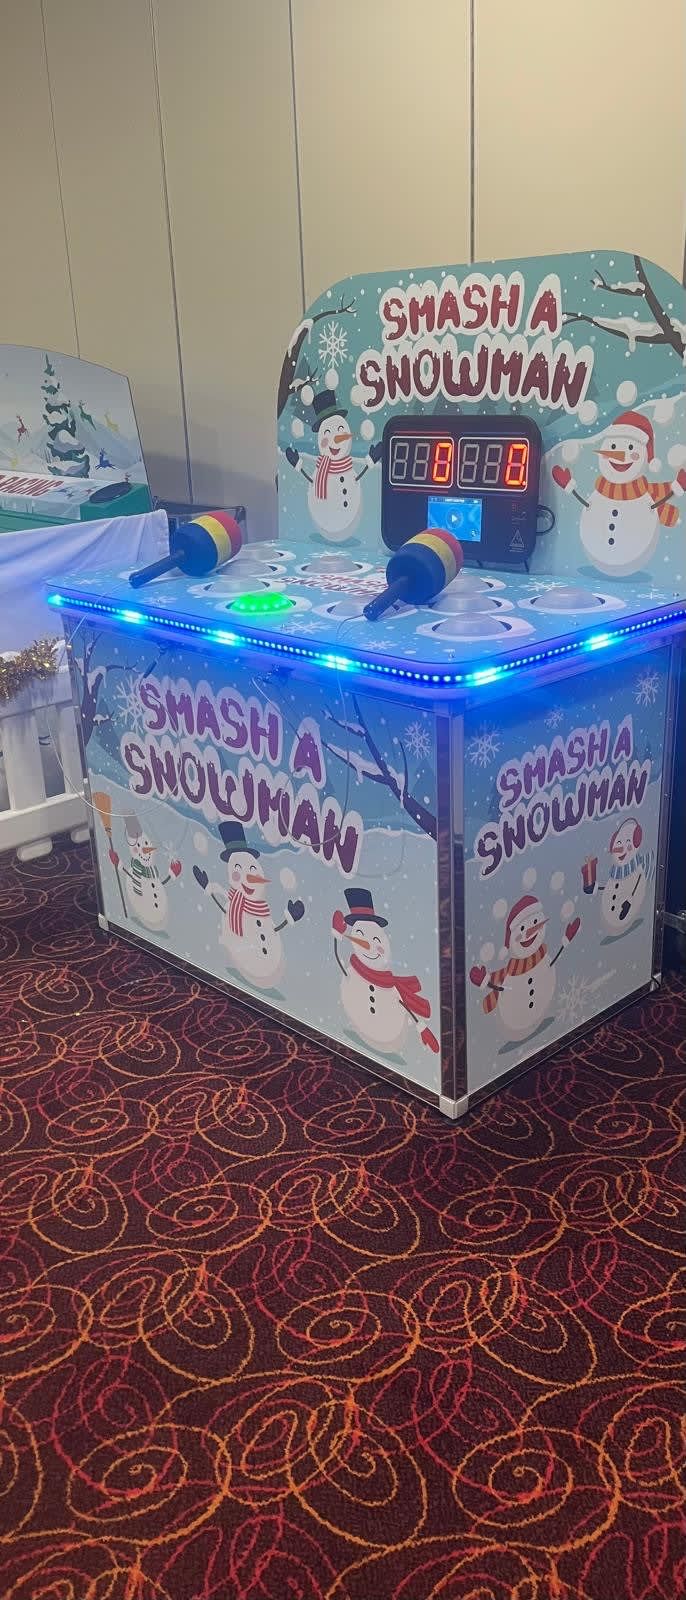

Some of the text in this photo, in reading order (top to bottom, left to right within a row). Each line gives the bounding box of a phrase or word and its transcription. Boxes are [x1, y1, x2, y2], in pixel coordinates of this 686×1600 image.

[383, 283, 558, 341] SMASH A
[359, 344, 588, 408] SNOWMAN
[139, 683, 322, 783] SMASH A
[500, 726, 631, 808] SMASH A
[124, 742, 359, 873] SNOWMAN
[477, 768, 648, 876] SNOWMAN
